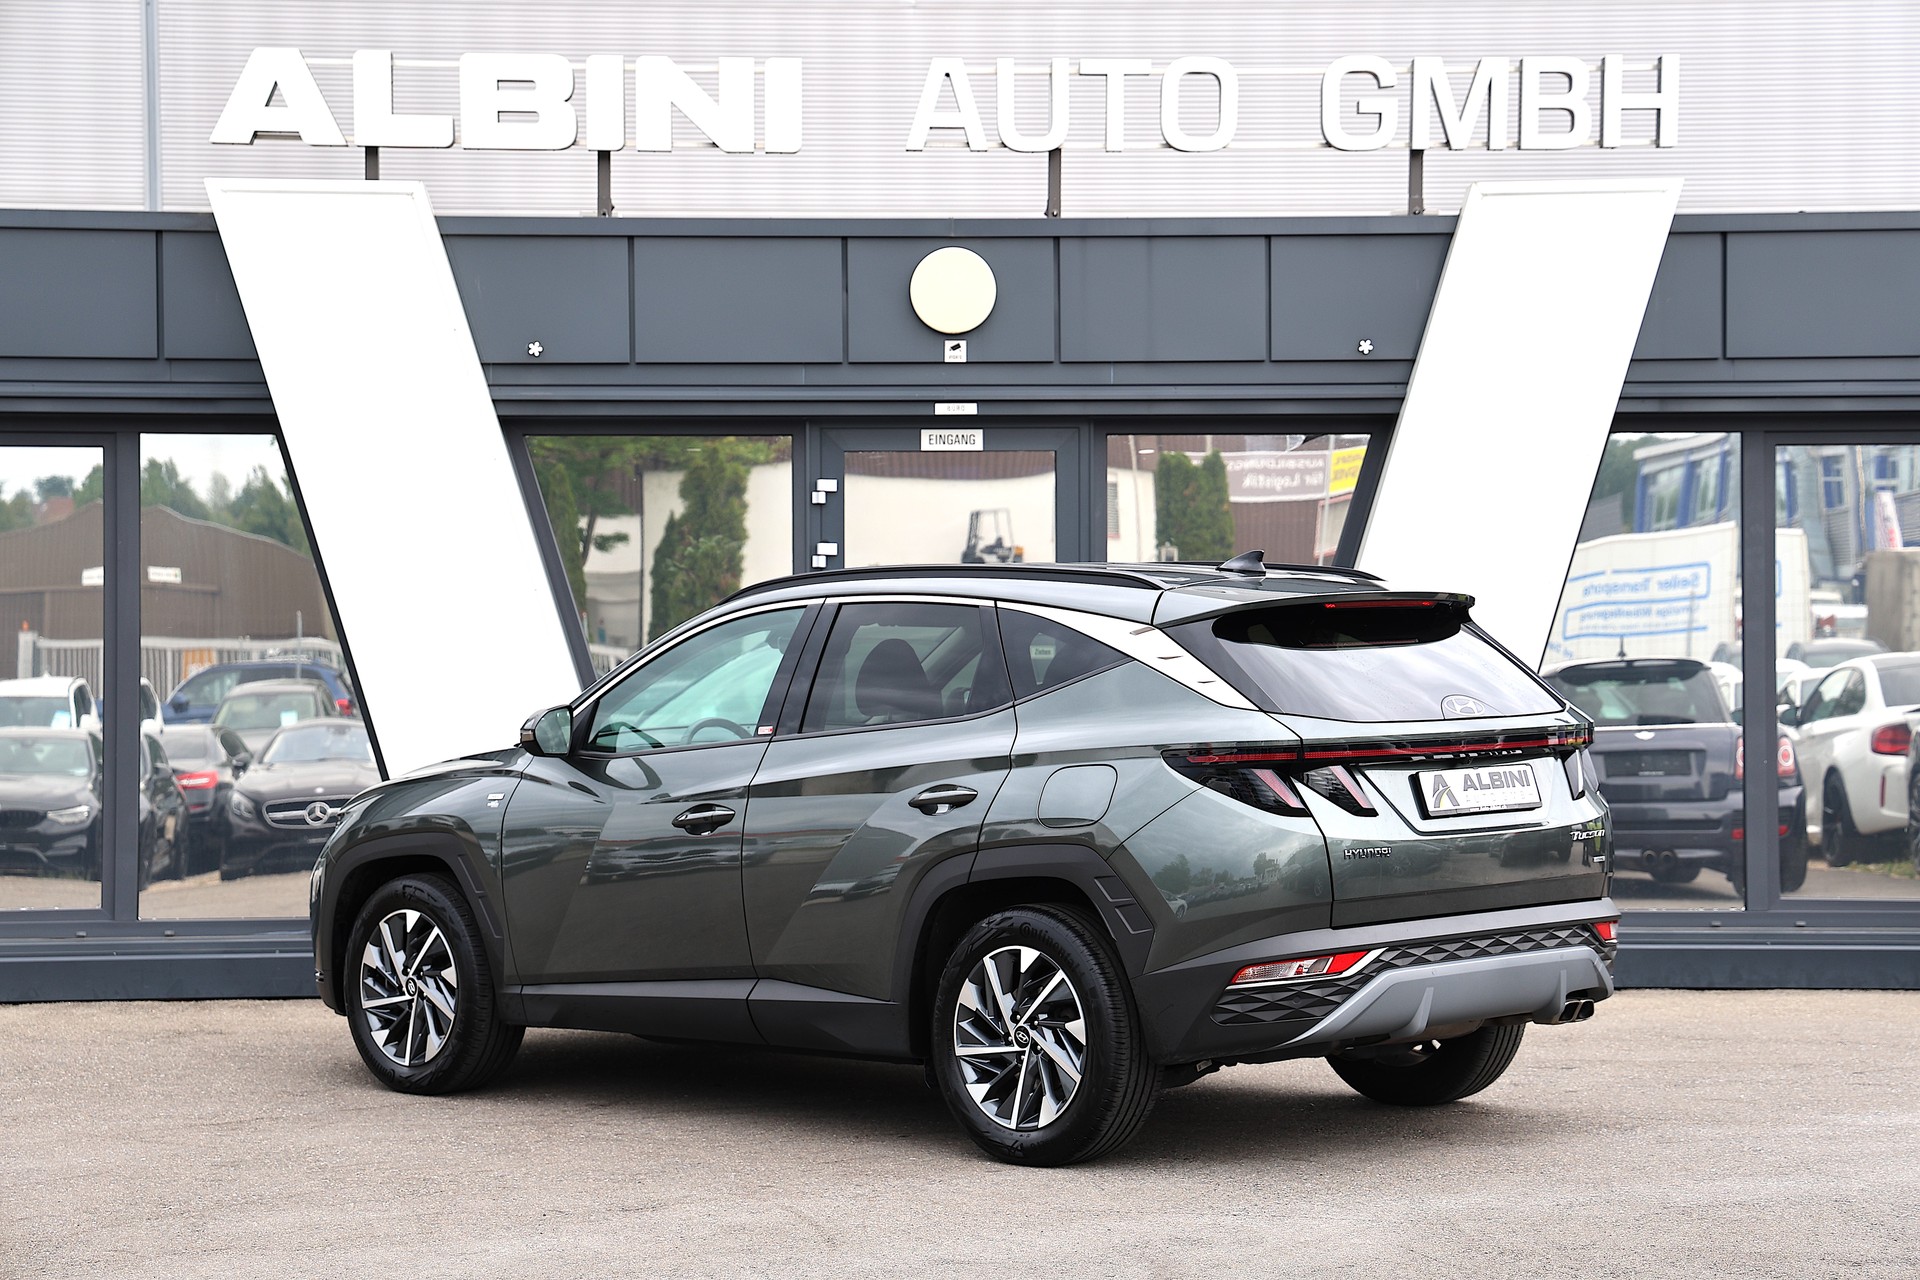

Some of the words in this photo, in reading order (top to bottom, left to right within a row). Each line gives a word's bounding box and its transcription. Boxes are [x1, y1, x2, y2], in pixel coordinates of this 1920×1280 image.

[208, 46, 803, 154] ALBINI
[905, 55, 1239, 153] AUTO
[1319, 53, 1682, 152] GMBH
[928, 433, 976, 445] EINGANG
[1463, 769, 1531, 791] ALBINI
